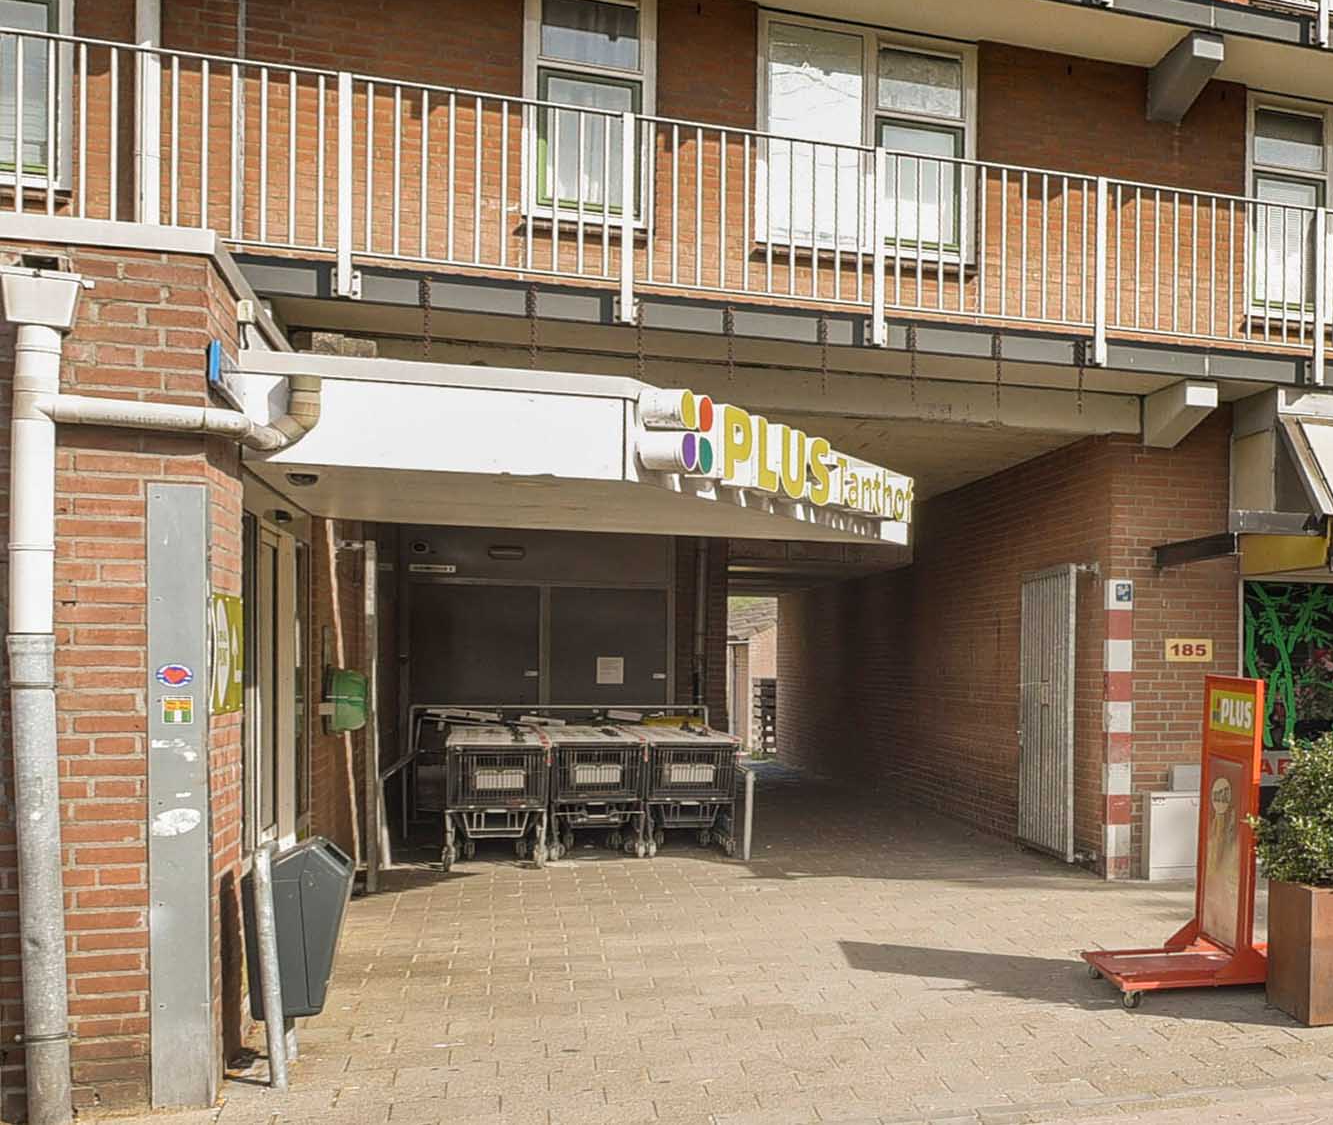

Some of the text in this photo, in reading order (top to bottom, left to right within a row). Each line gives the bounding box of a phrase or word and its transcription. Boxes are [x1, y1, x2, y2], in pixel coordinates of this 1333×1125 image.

[723, 404, 831, 506] PLUS
[836, 457, 914, 522] Tanthof
[1170, 643, 1207, 657] 185
[1219, 697, 1253, 730] PLUS
